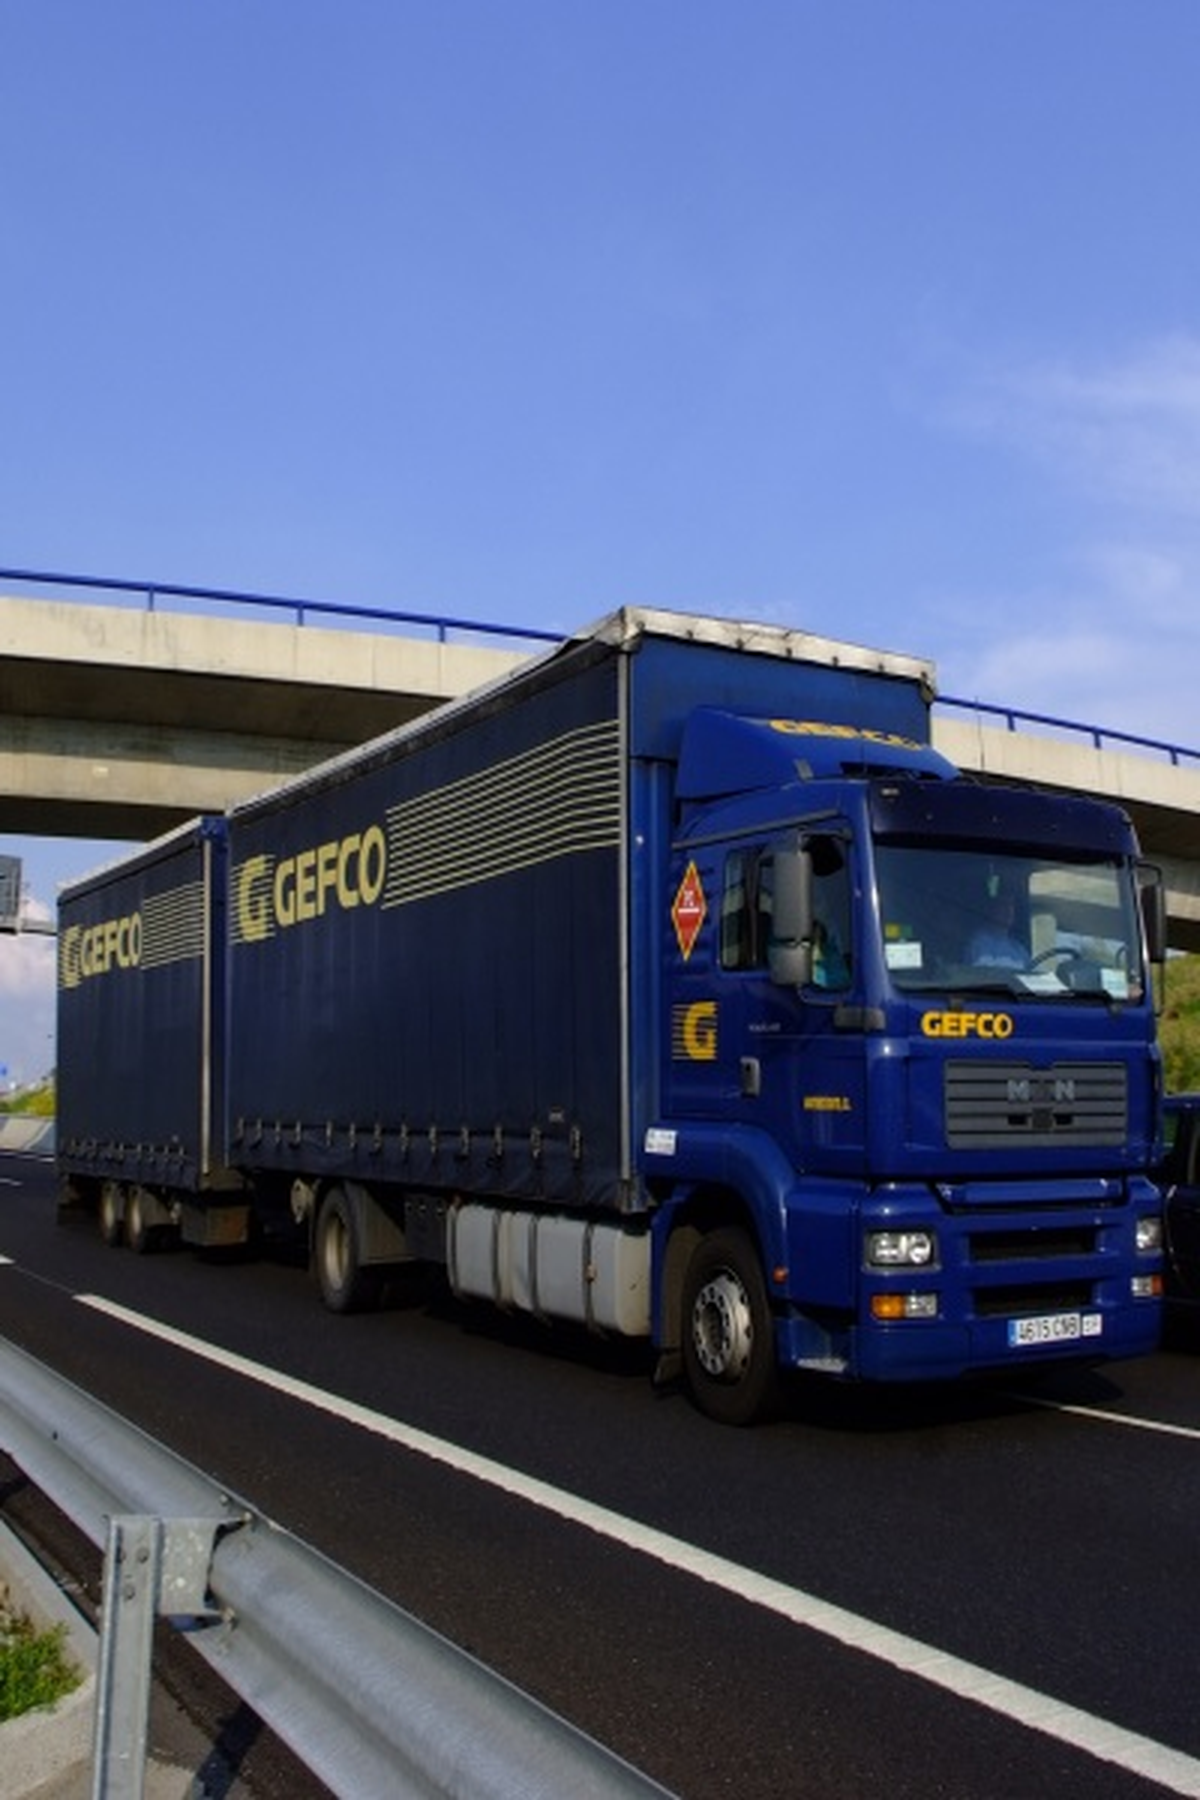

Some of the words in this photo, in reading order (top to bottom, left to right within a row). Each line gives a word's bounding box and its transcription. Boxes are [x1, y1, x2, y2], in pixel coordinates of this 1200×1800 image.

[274, 825, 386, 927] GEFCO
[81, 911, 142, 977] GEFCO
[677, 1002, 717, 1060] G
[920, 1010, 1014, 1039] GEFCO
[1007, 1079, 1075, 1101] MN
